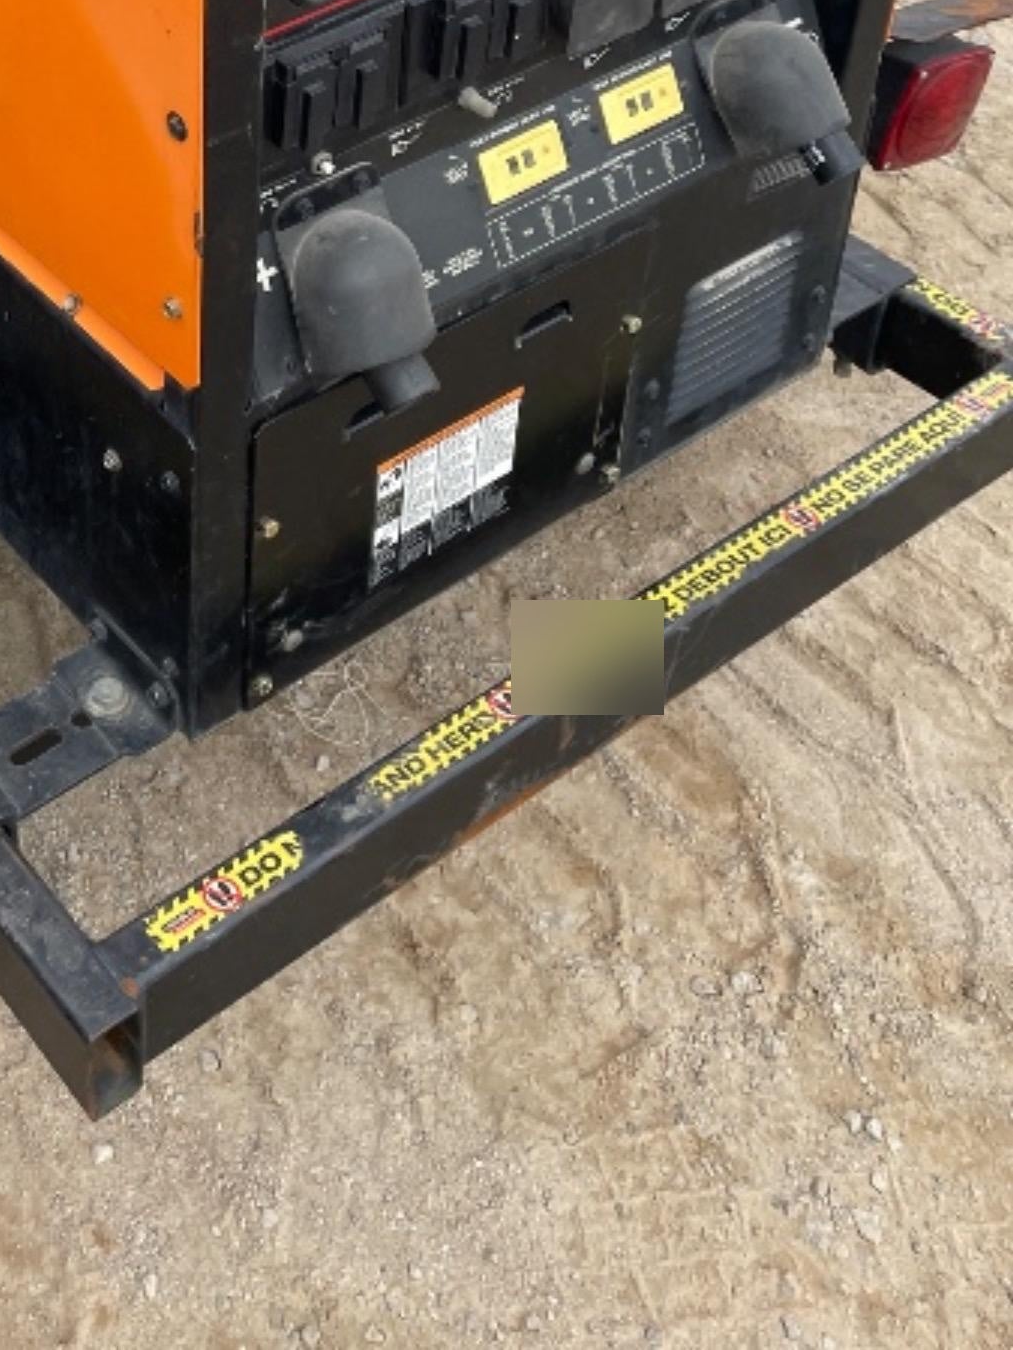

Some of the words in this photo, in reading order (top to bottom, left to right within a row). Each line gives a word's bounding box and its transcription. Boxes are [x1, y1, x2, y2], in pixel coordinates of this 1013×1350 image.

[811, 488, 847, 512] NO
[671, 542, 762, 602] DEBOUT
[757, 523, 792, 547] ICI
[237, 851, 283, 886] DO
